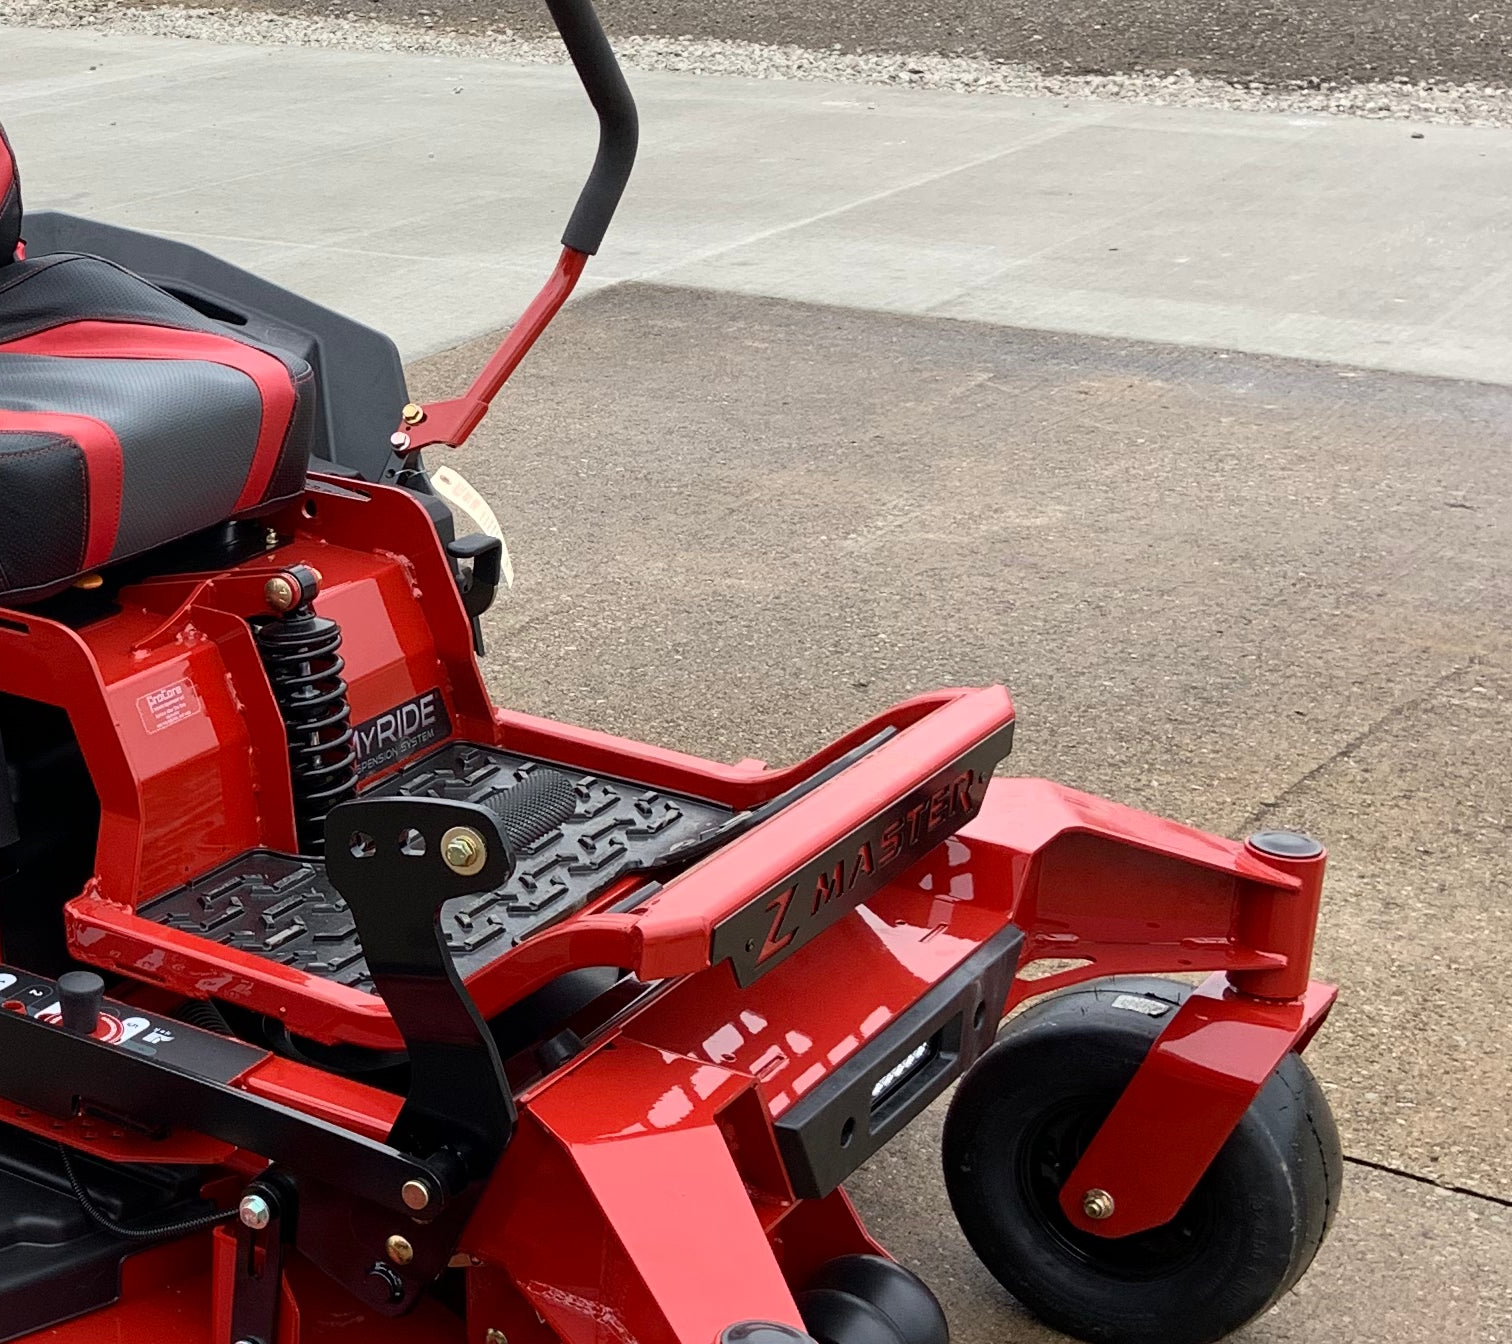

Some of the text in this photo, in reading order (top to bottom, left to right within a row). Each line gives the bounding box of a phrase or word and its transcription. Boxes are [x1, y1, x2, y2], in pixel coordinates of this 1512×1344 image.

[400, 728, 435, 753] SYSTEM
[755, 767, 977, 966] Z MASTER
